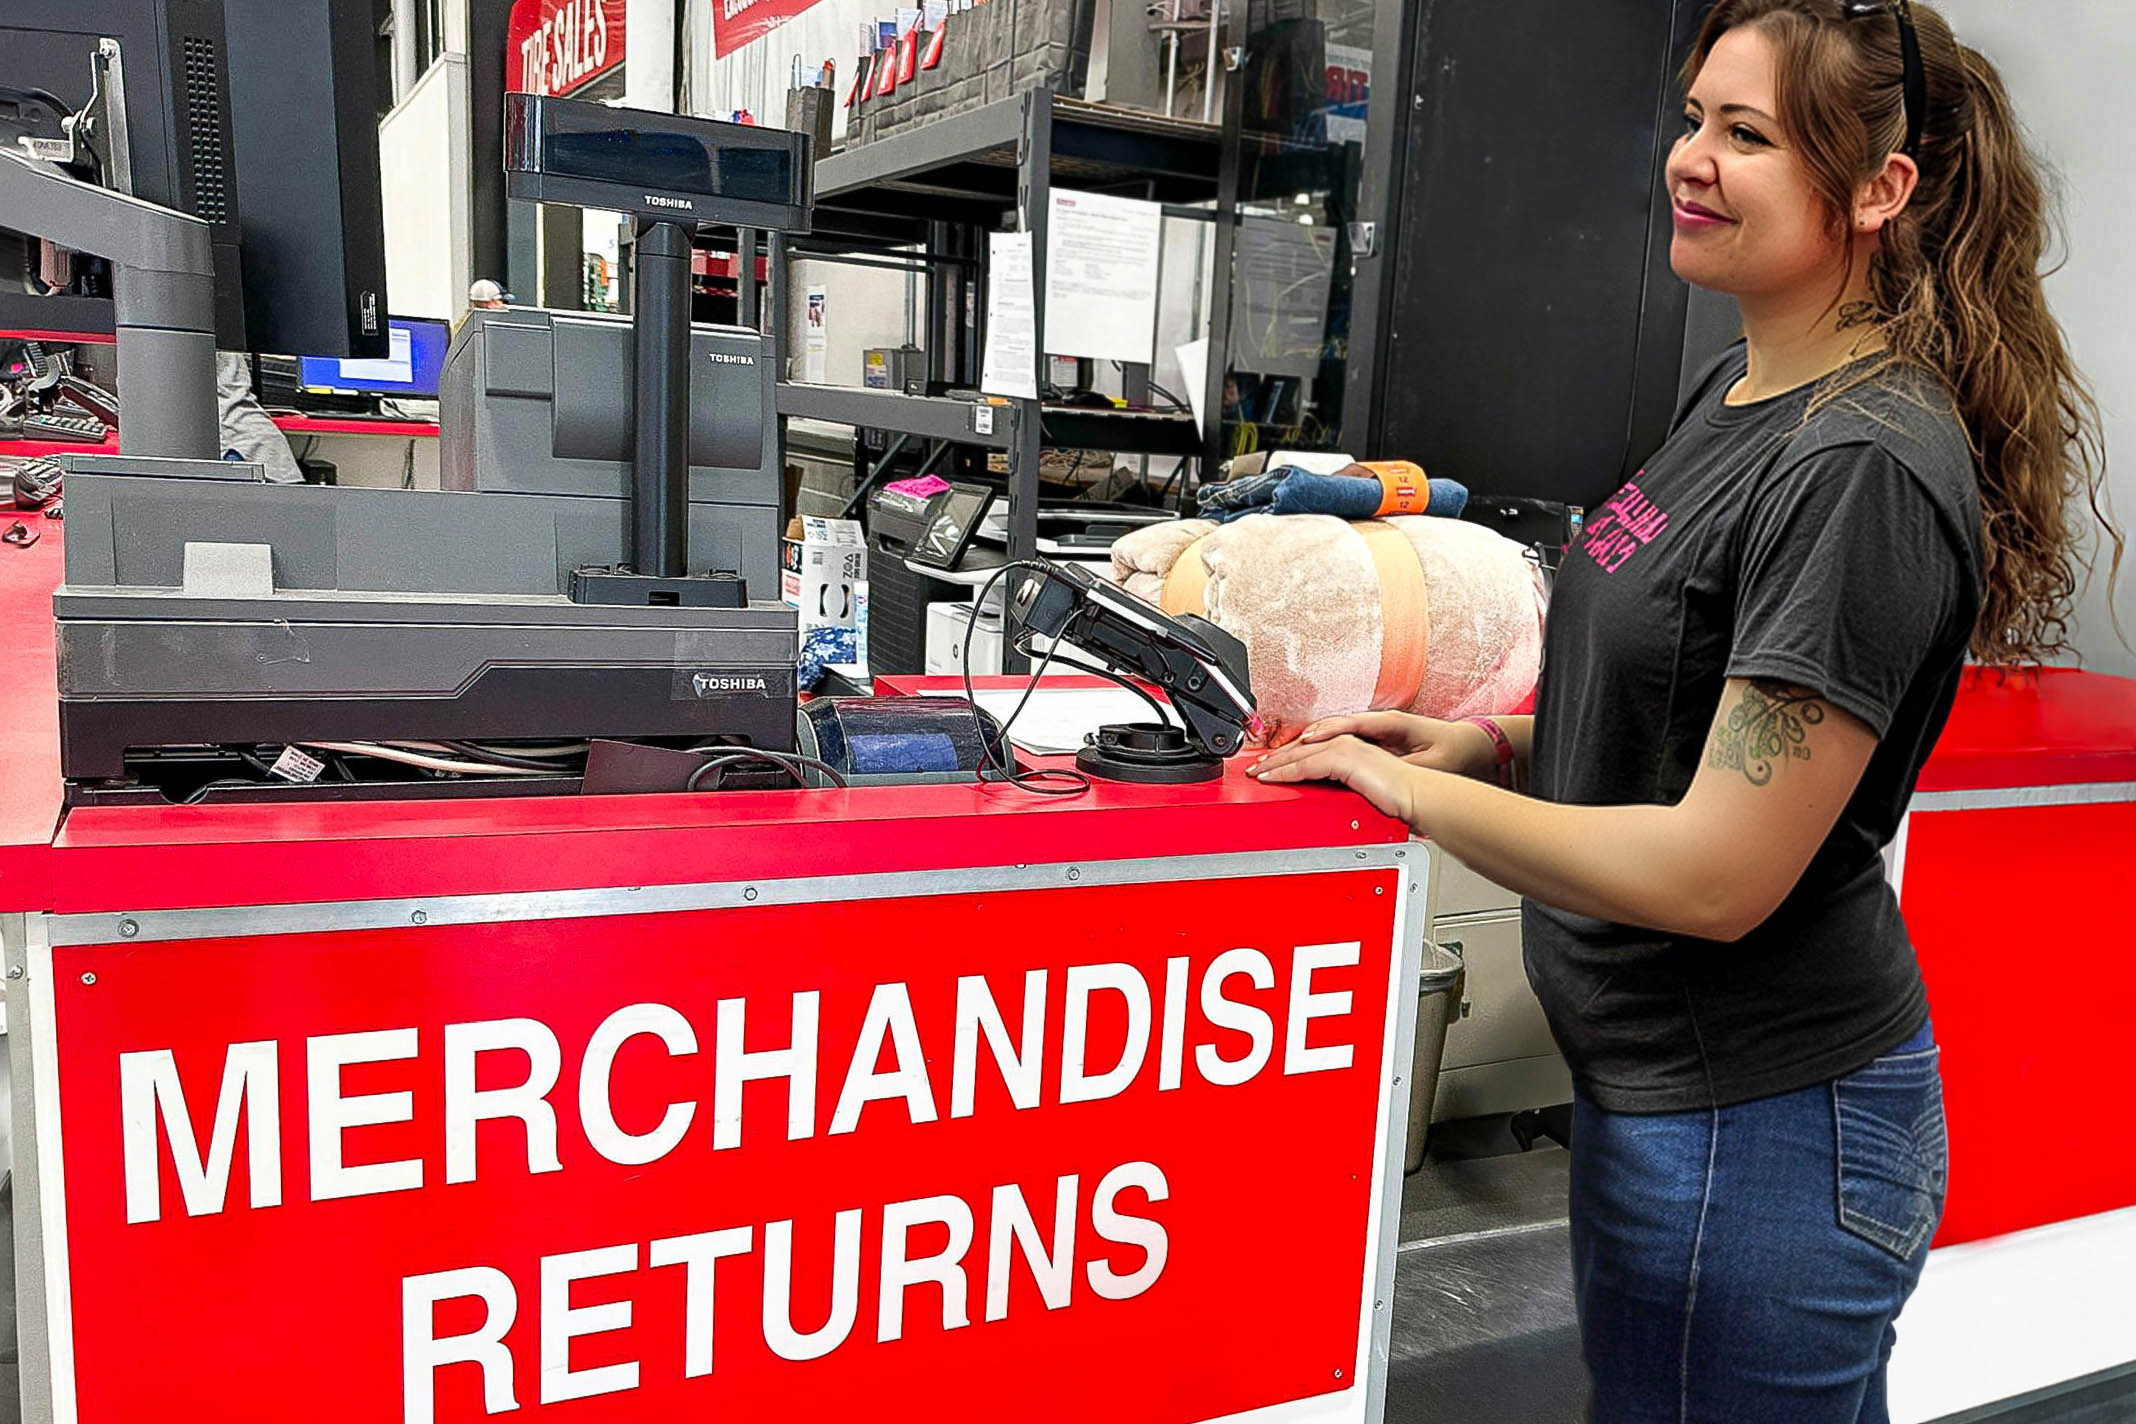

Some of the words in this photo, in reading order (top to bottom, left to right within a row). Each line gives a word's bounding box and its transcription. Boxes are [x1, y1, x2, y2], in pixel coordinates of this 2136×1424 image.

[521, 20, 550, 96] TIRE
[552, 0, 607, 92] SALES
[644, 194, 693, 210] TOSHIBA
[709, 353, 754, 365] TOSHIBA
[699, 678, 766, 690] TOSHIBA
[120, 941, 1361, 1224] MERCHANDISE
[402, 1161, 1169, 1424] RETURNS
